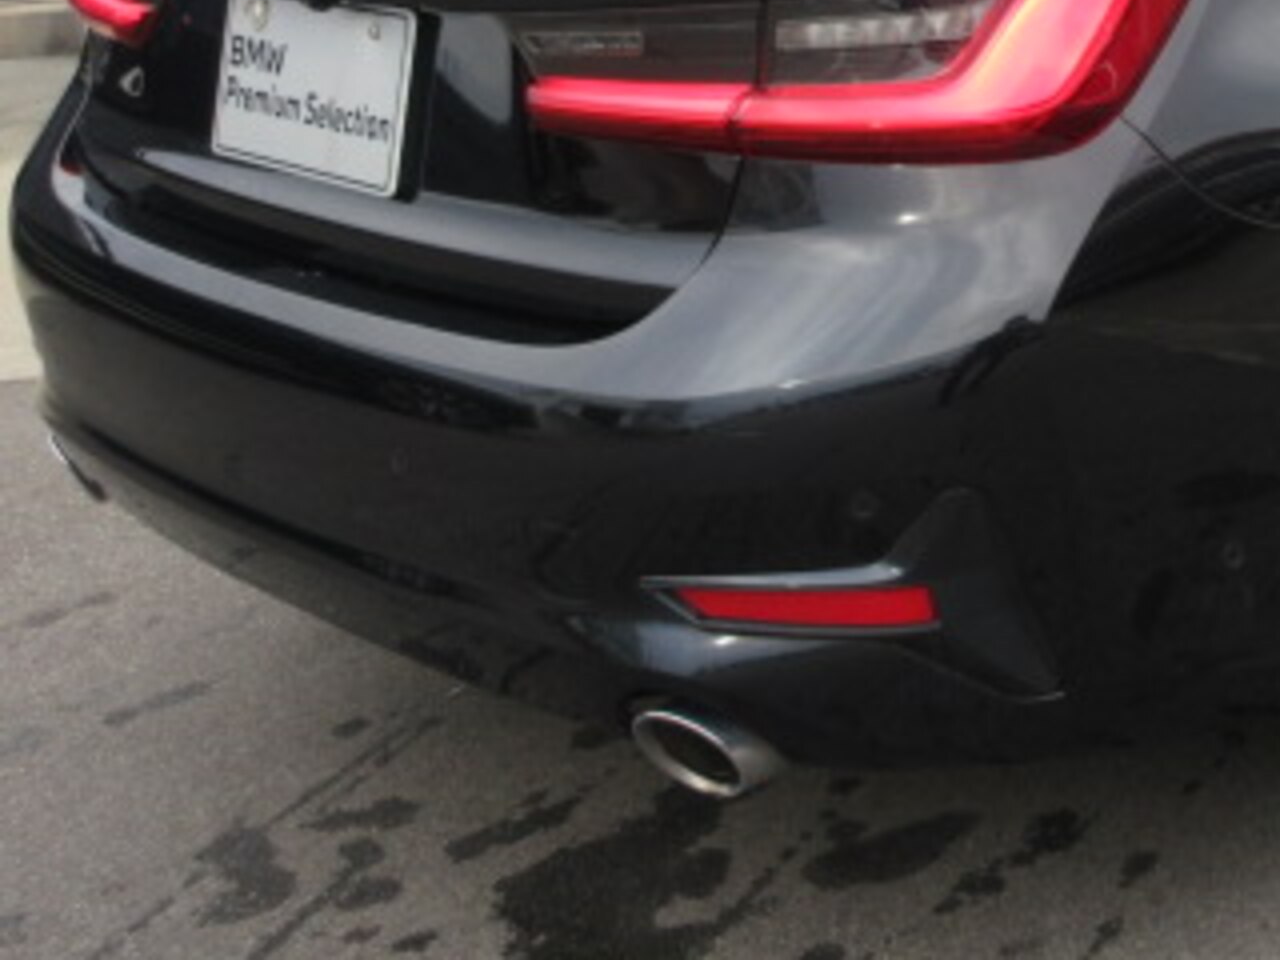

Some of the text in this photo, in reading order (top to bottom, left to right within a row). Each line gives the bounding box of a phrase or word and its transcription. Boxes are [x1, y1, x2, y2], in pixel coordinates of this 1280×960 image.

[231, 35, 288, 74] BMW
[224, 76, 390, 143] Premium Selection
